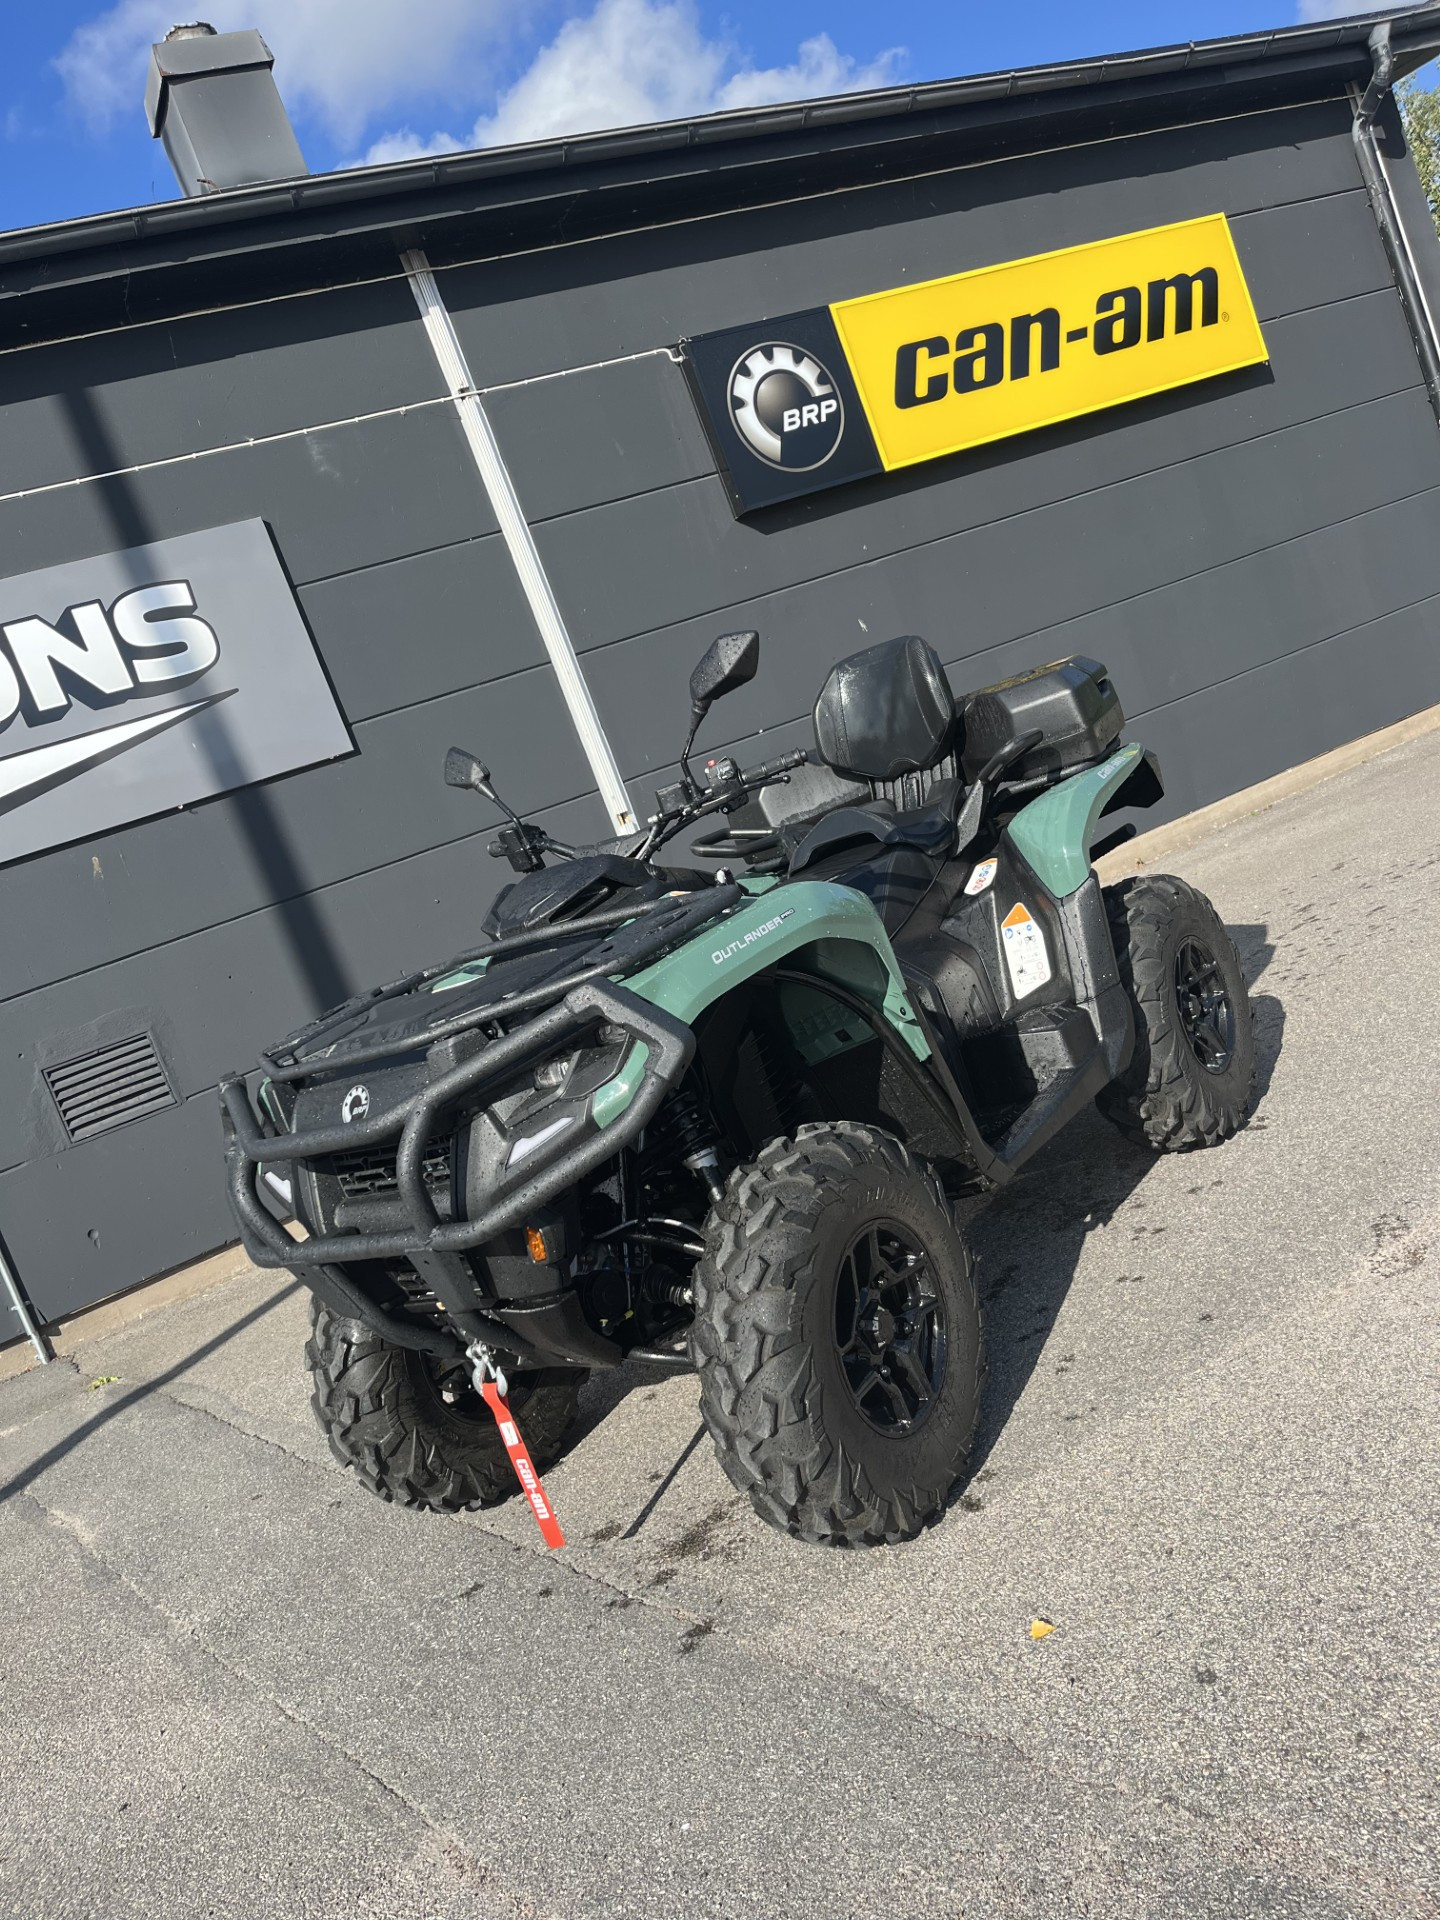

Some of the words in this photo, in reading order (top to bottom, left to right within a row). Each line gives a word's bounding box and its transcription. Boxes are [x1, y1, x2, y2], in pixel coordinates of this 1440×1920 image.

[894, 265, 1218, 410] can-am
[783, 399, 838, 432] BRP
[0, 579, 220, 724] NS
[711, 916, 784, 965] OUTLANDER
[780, 908, 795, 919] PRO
[515, 1458, 550, 1520] can-am
